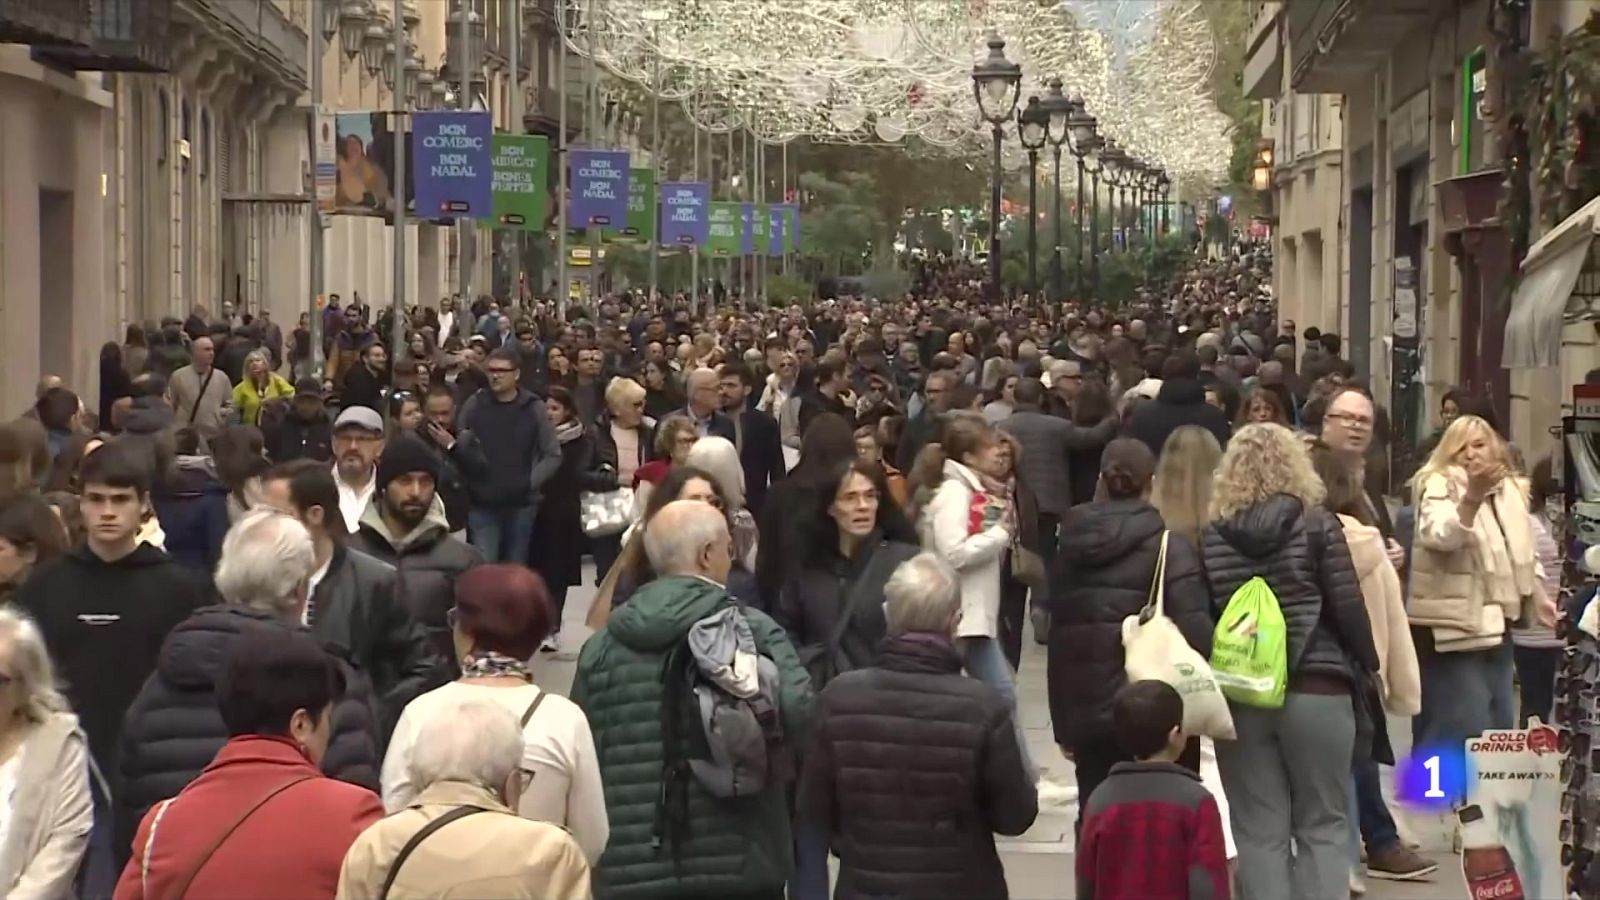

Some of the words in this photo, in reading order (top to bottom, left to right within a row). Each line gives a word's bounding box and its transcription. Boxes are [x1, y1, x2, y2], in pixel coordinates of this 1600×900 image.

[439, 124, 466, 135] BON
[423, 136, 483, 151] COMERÇ
[500, 145, 524, 155] BON
[439, 154, 467, 165] BON
[431, 166, 476, 177] NADAL
[583, 190, 616, 199] NADAL
[1489, 732, 1526, 742] COLD
[1470, 742, 1525, 752] DRINKS
[1478, 771, 1505, 780] TAKE
